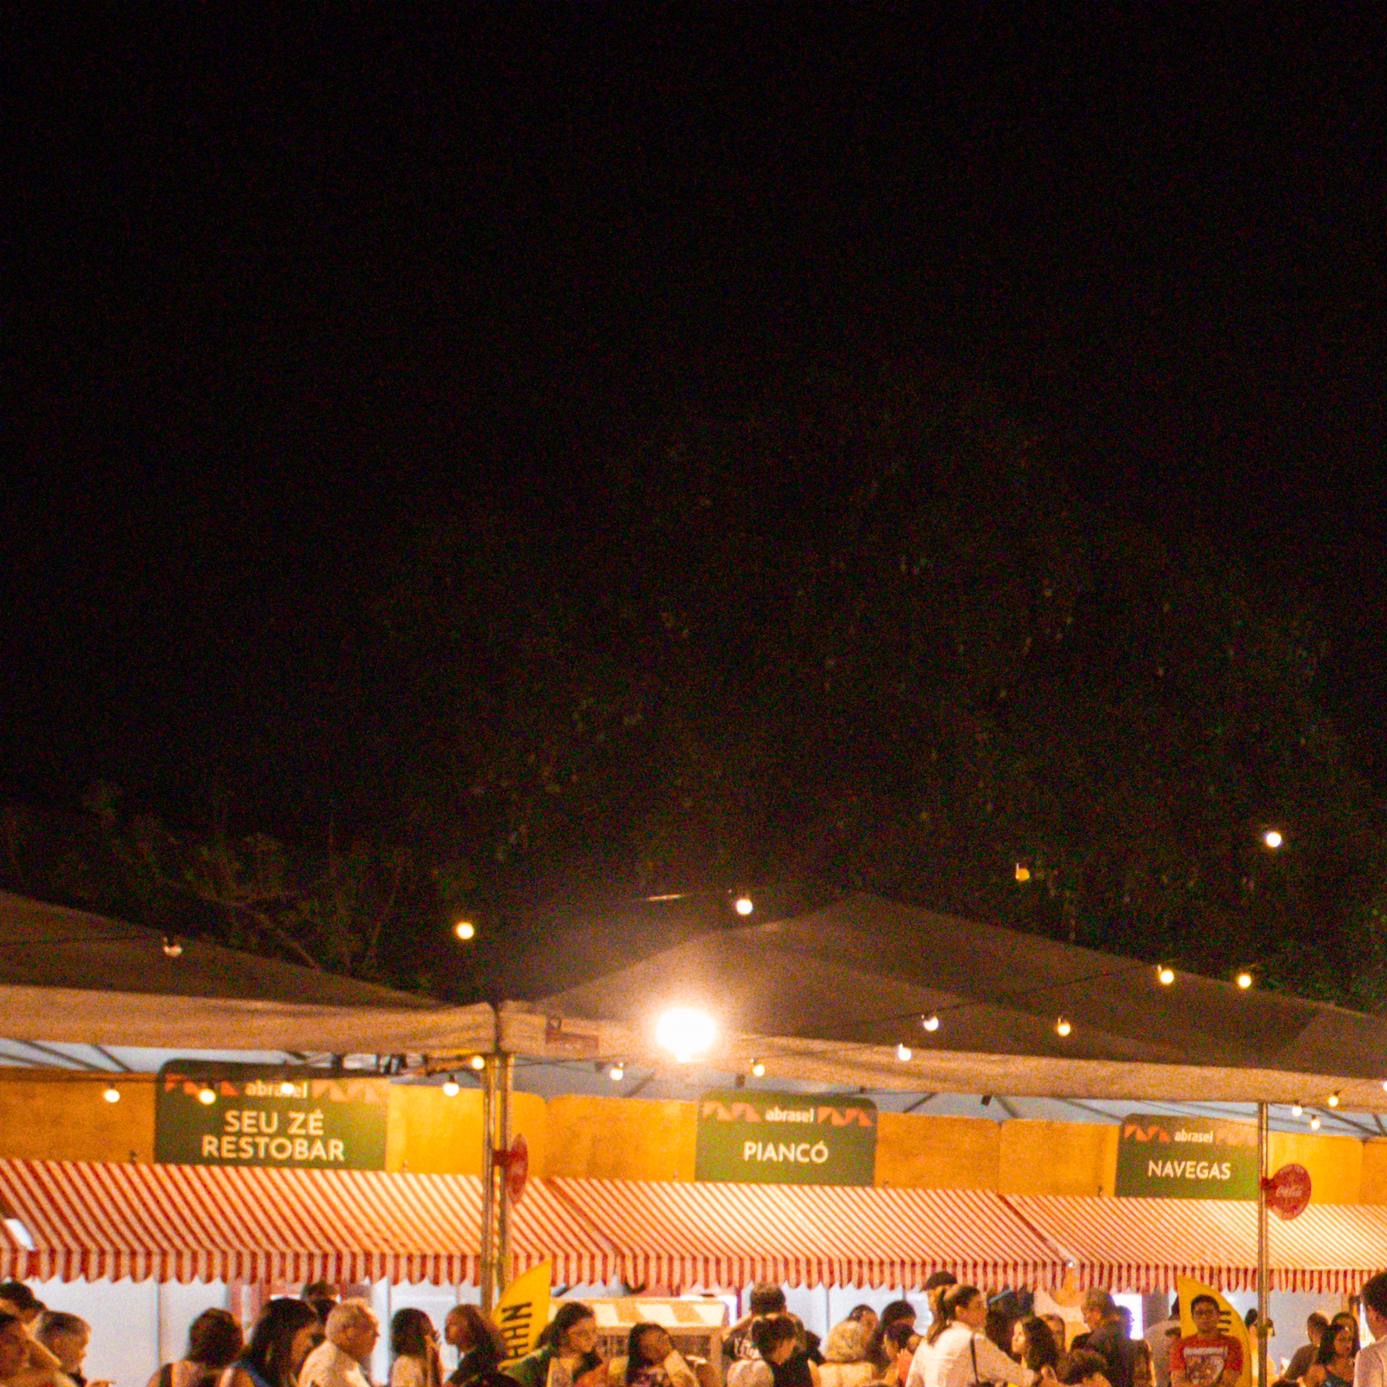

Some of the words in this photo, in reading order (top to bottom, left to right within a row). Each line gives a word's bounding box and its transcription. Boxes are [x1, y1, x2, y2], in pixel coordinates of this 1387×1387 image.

[244, 1079, 308, 1099] abrael
[224, 1109, 279, 1135] SEU
[287, 1108, 325, 1136] ZÉ
[765, 1105, 815, 1123] abrasel
[1173, 1128, 1214, 1144] abrasel
[201, 1134, 345, 1162] RESTOBAR
[743, 1140, 829, 1164] PIANCÓ
[1147, 1160, 1232, 1180] NAVEGAS
